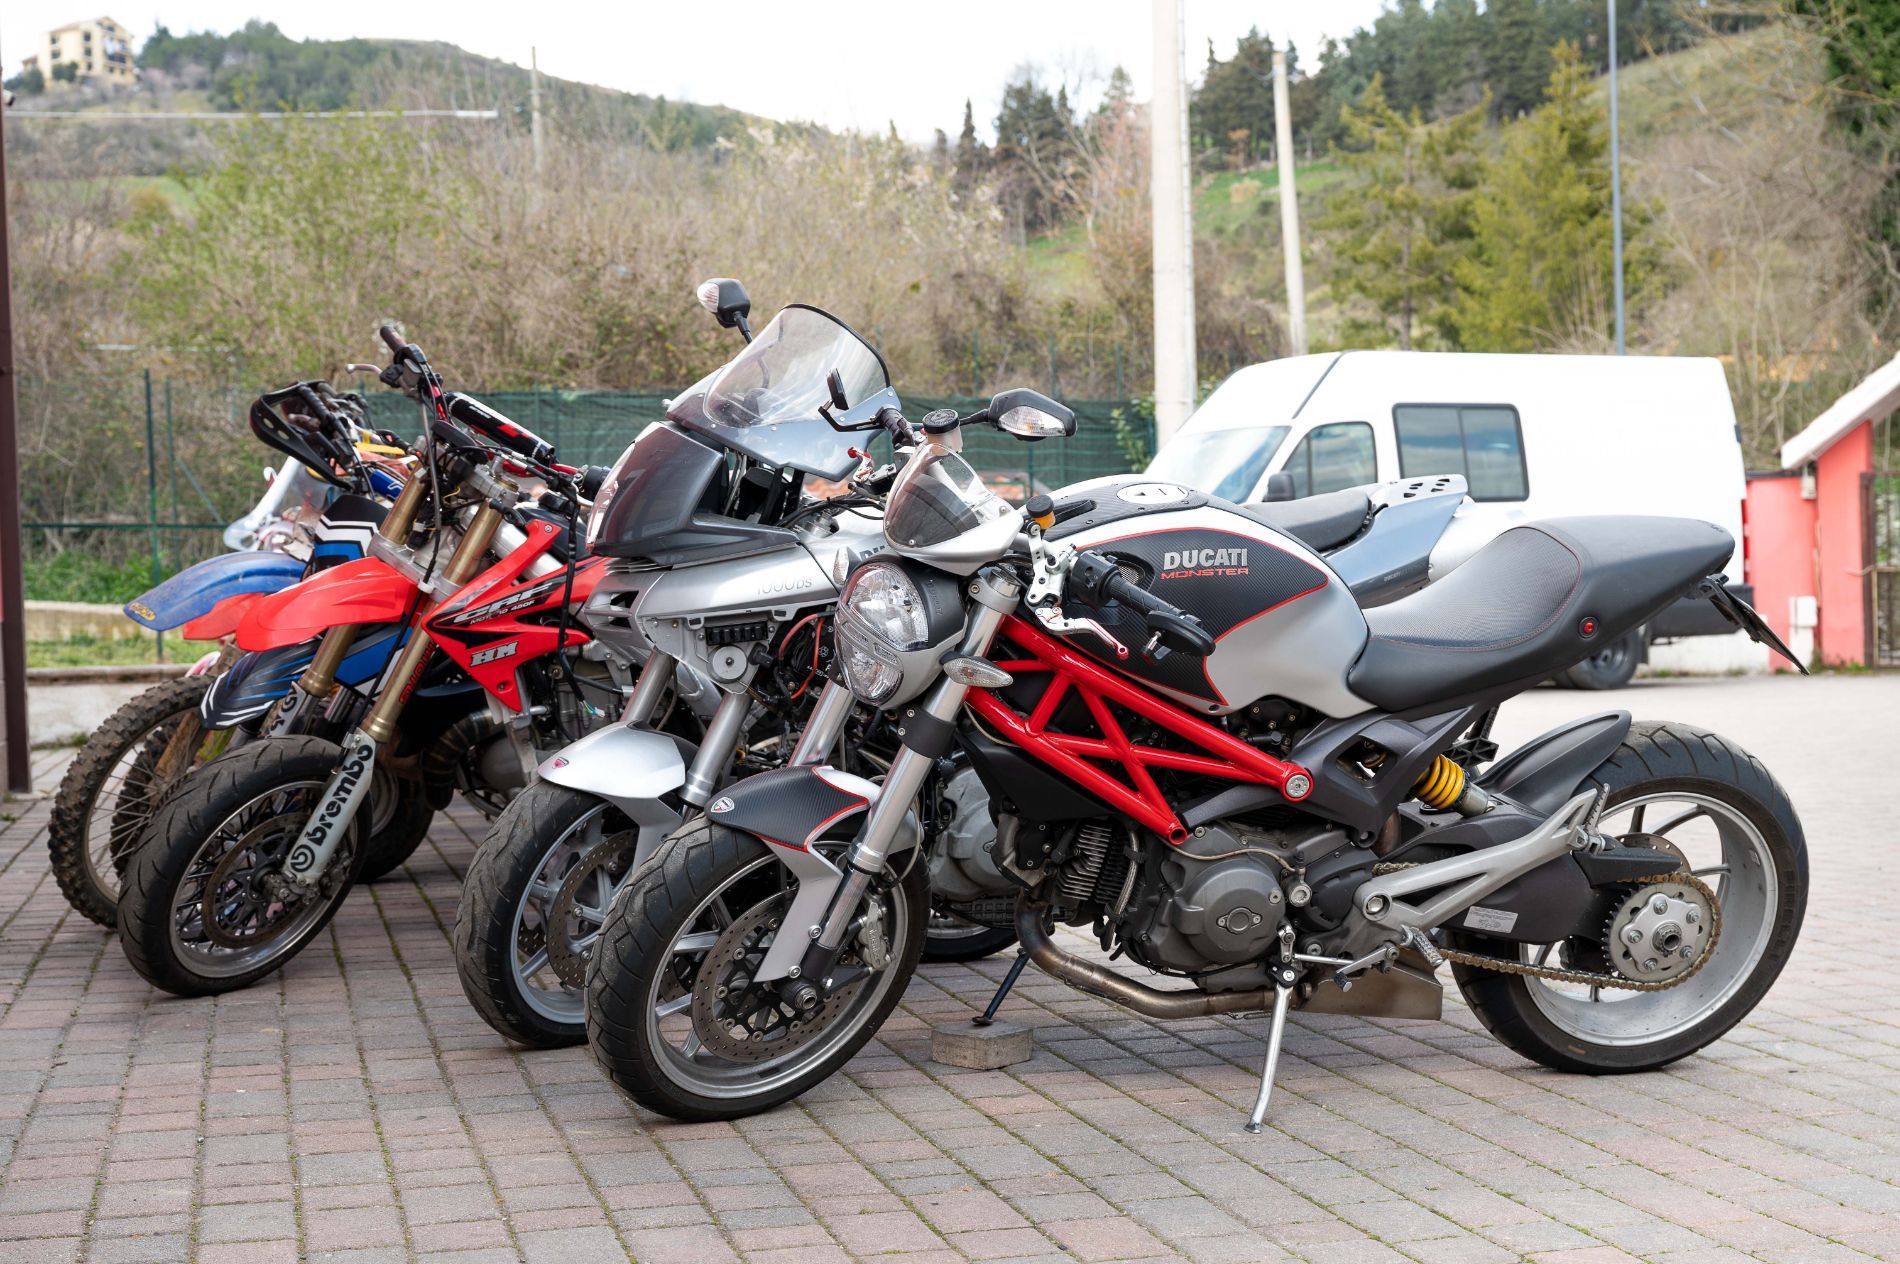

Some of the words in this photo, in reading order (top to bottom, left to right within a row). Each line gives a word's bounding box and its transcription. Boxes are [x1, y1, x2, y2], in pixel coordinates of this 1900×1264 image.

[1163, 548, 1248, 570] DUCATI
[1160, 567, 1249, 580] MONSTER
[453, 582, 553, 624] CRF
[470, 640, 519, 667] HM
[304, 744, 374, 847] brembo
